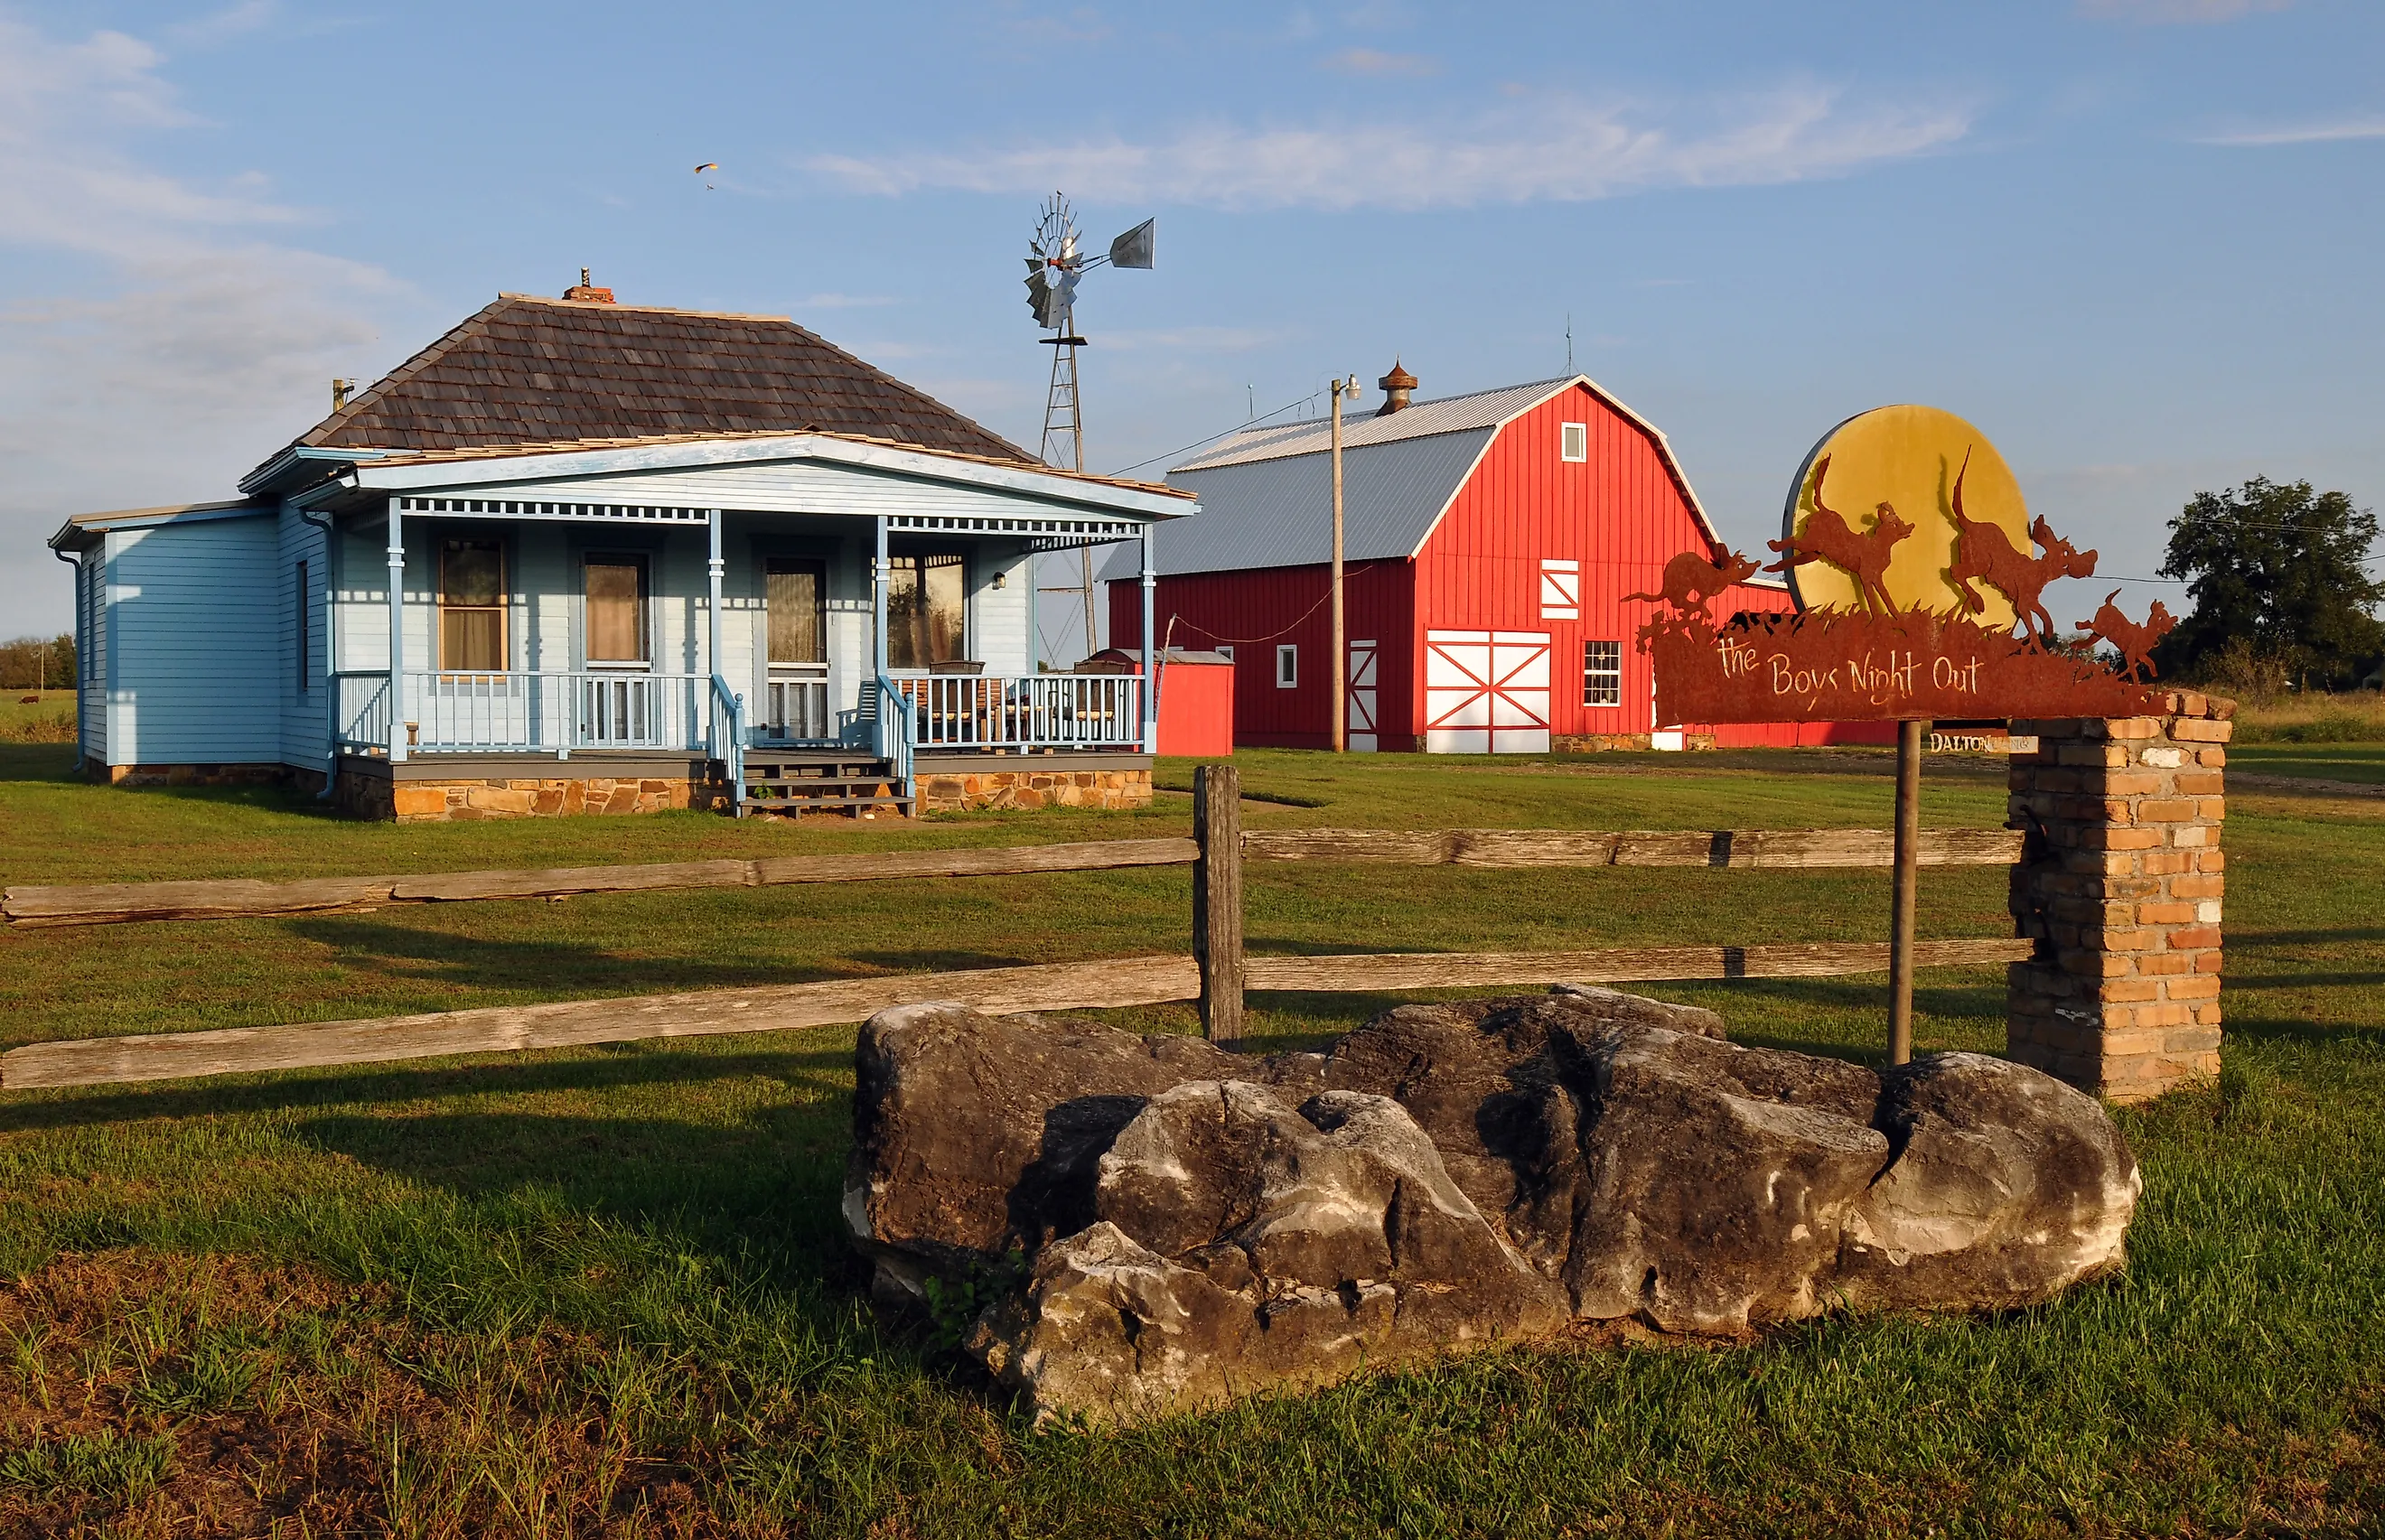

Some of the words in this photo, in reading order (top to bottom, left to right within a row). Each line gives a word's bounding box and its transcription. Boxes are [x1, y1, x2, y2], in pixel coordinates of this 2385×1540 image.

[1716, 637, 1760, 678] the
[1767, 653, 1838, 712] Boys
[1847, 649, 1922, 705] Night
[1933, 656, 1985, 695] Out
[1930, 733, 1992, 753] DALTON
